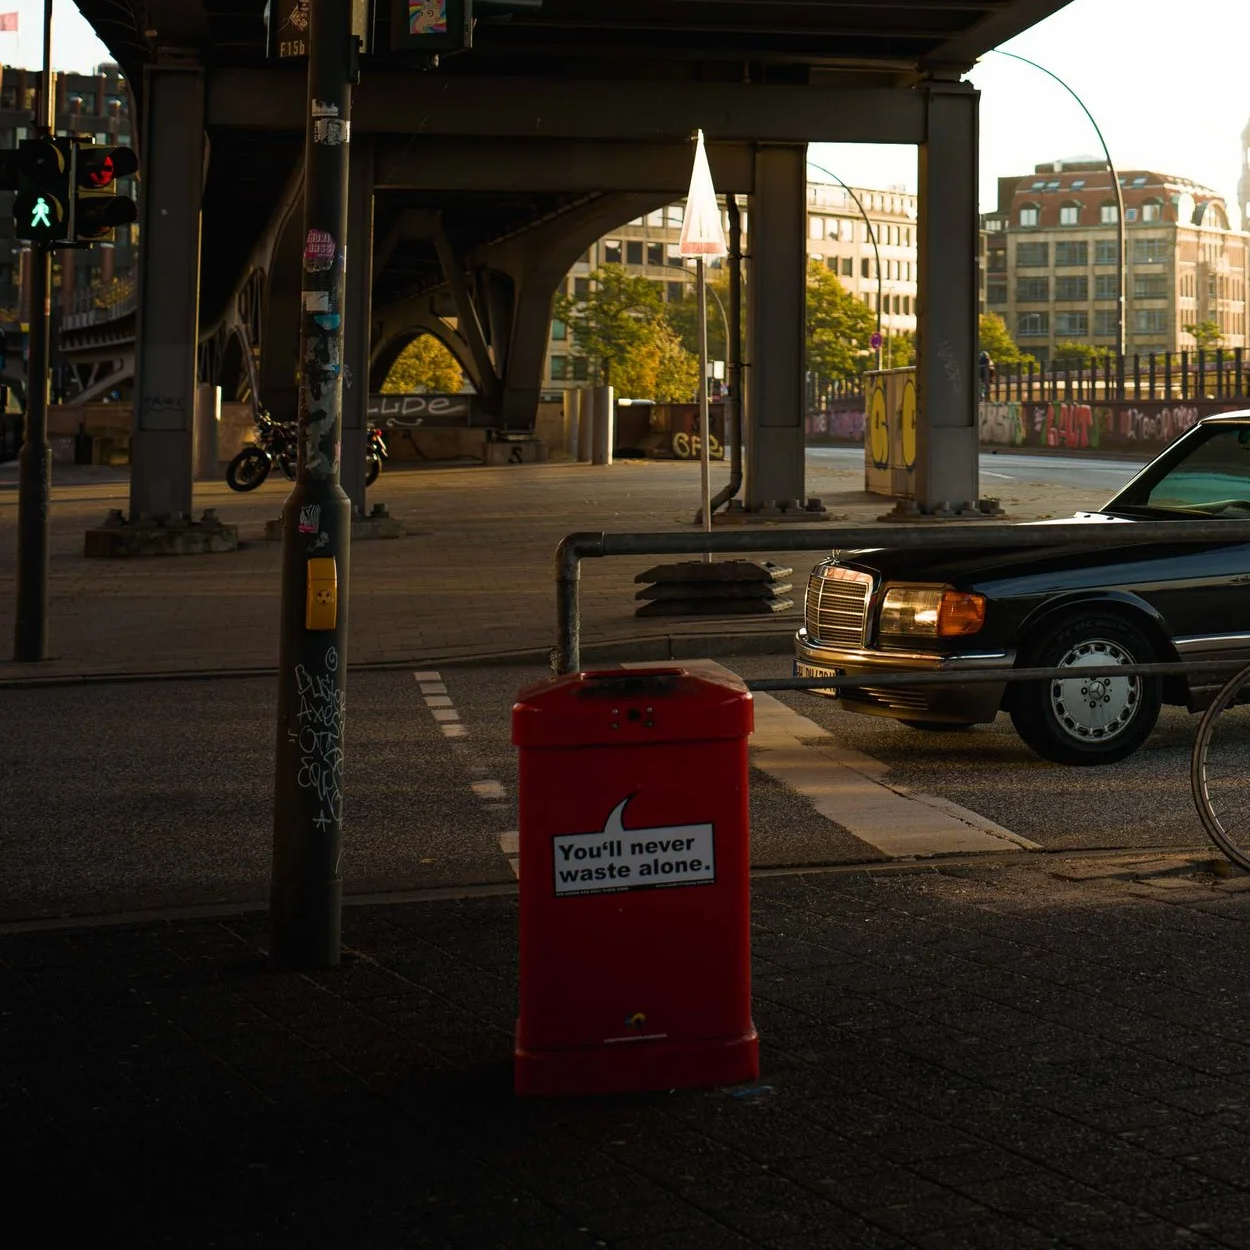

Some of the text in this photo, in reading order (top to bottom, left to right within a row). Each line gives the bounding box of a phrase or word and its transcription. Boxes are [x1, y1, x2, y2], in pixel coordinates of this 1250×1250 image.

[559, 837, 695, 860] You'll never
[560, 858, 710, 883] waste alone.
